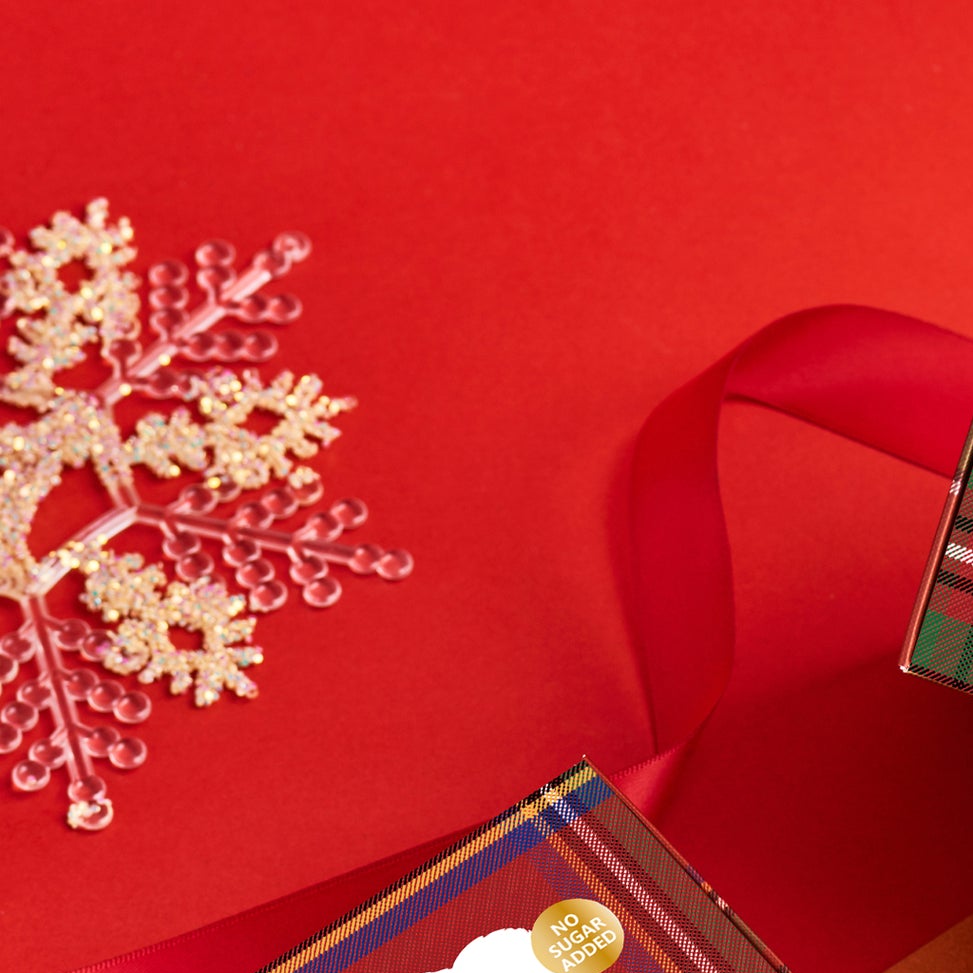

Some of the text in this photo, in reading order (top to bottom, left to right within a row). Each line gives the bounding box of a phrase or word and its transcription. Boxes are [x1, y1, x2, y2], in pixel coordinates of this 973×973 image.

[548, 917, 607, 958] SUGAR
[550, 913, 579, 937] NO
[561, 930, 617, 972] ADDED
